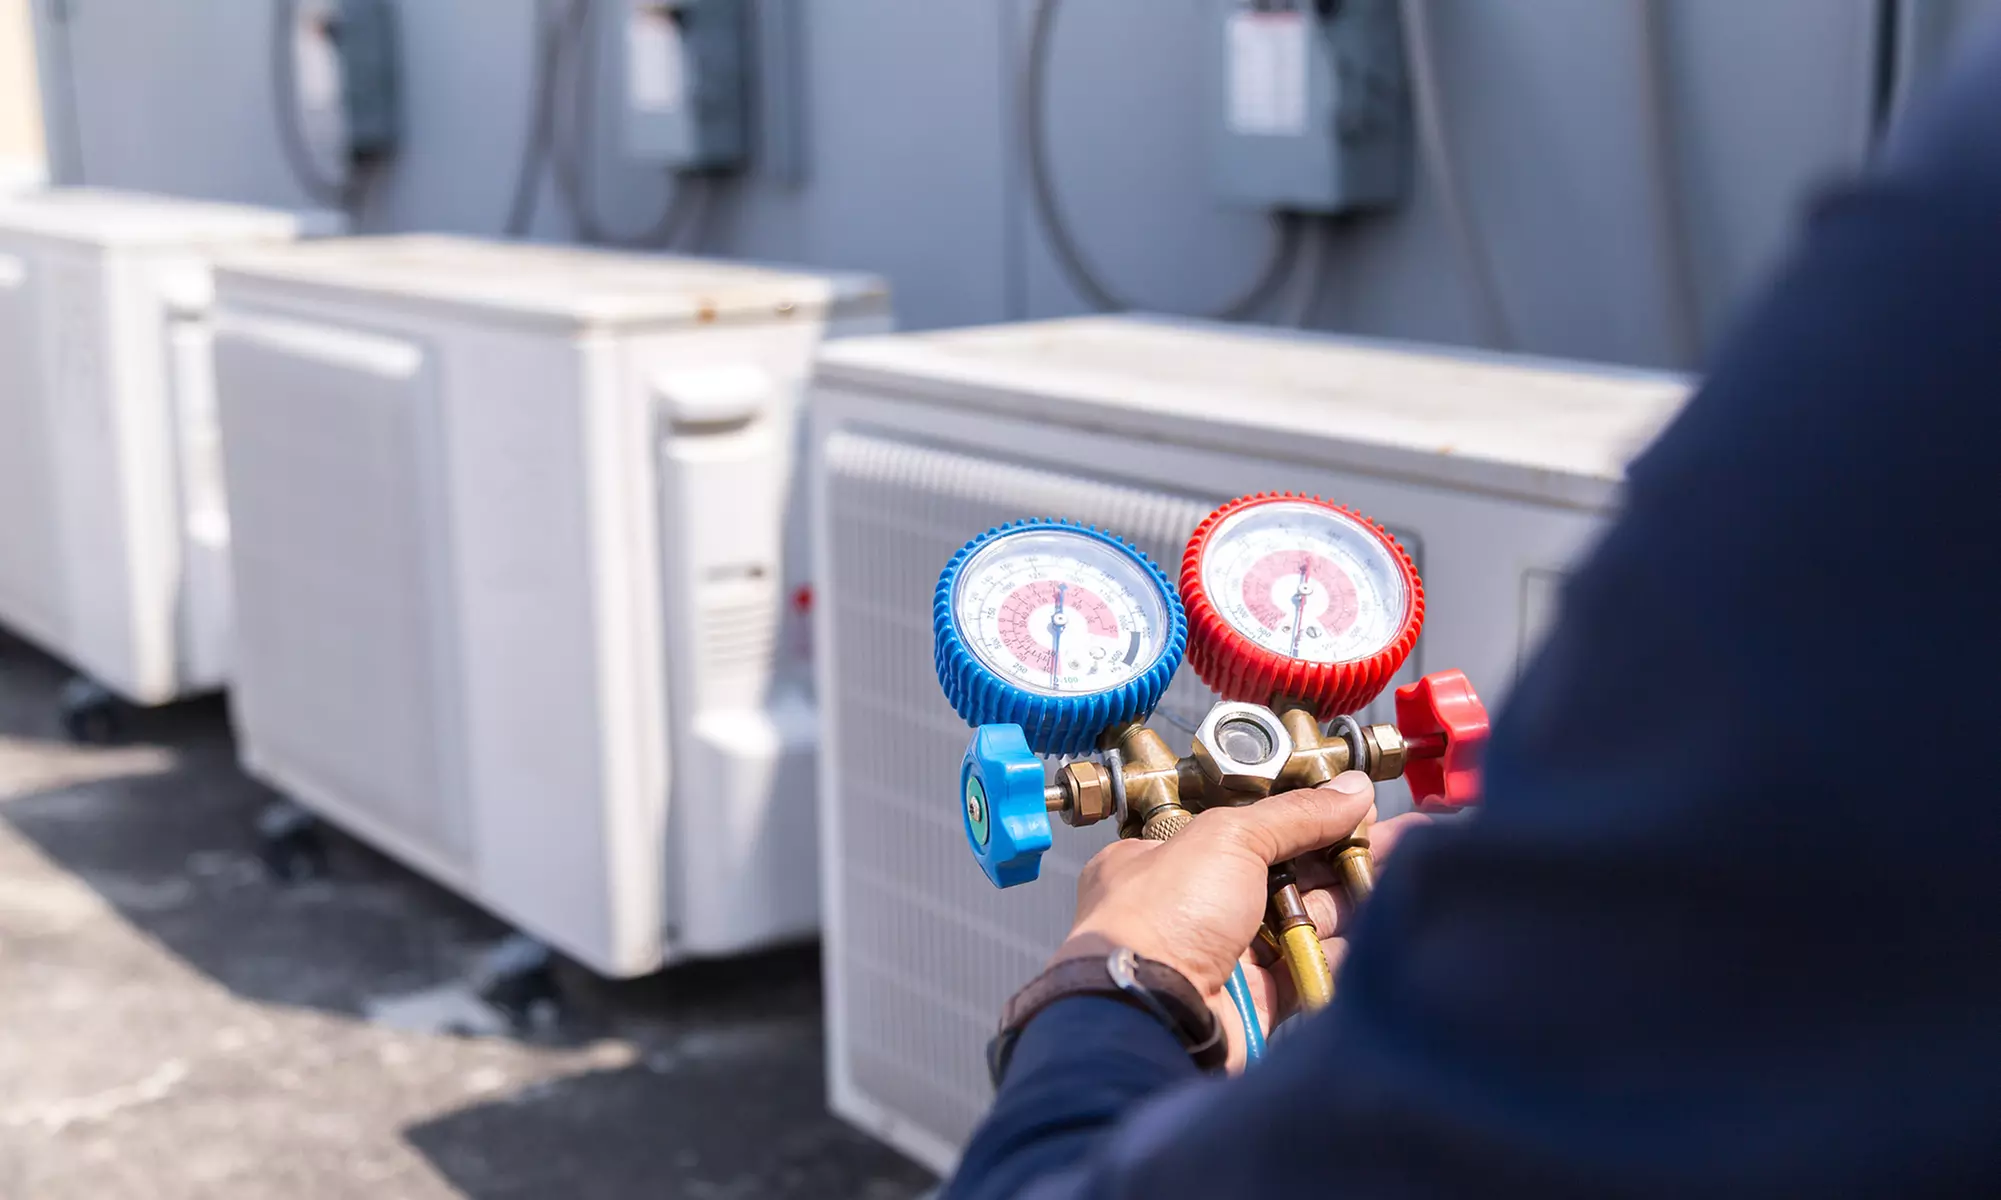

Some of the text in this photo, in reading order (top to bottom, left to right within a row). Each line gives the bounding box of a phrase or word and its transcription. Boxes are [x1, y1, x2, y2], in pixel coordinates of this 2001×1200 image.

[1010, 591, 1020, 600] 10
[986, 606, 997, 619] 750
[1257, 626, 1272, 638] 500
[1012, 662, 1029, 674] 250
